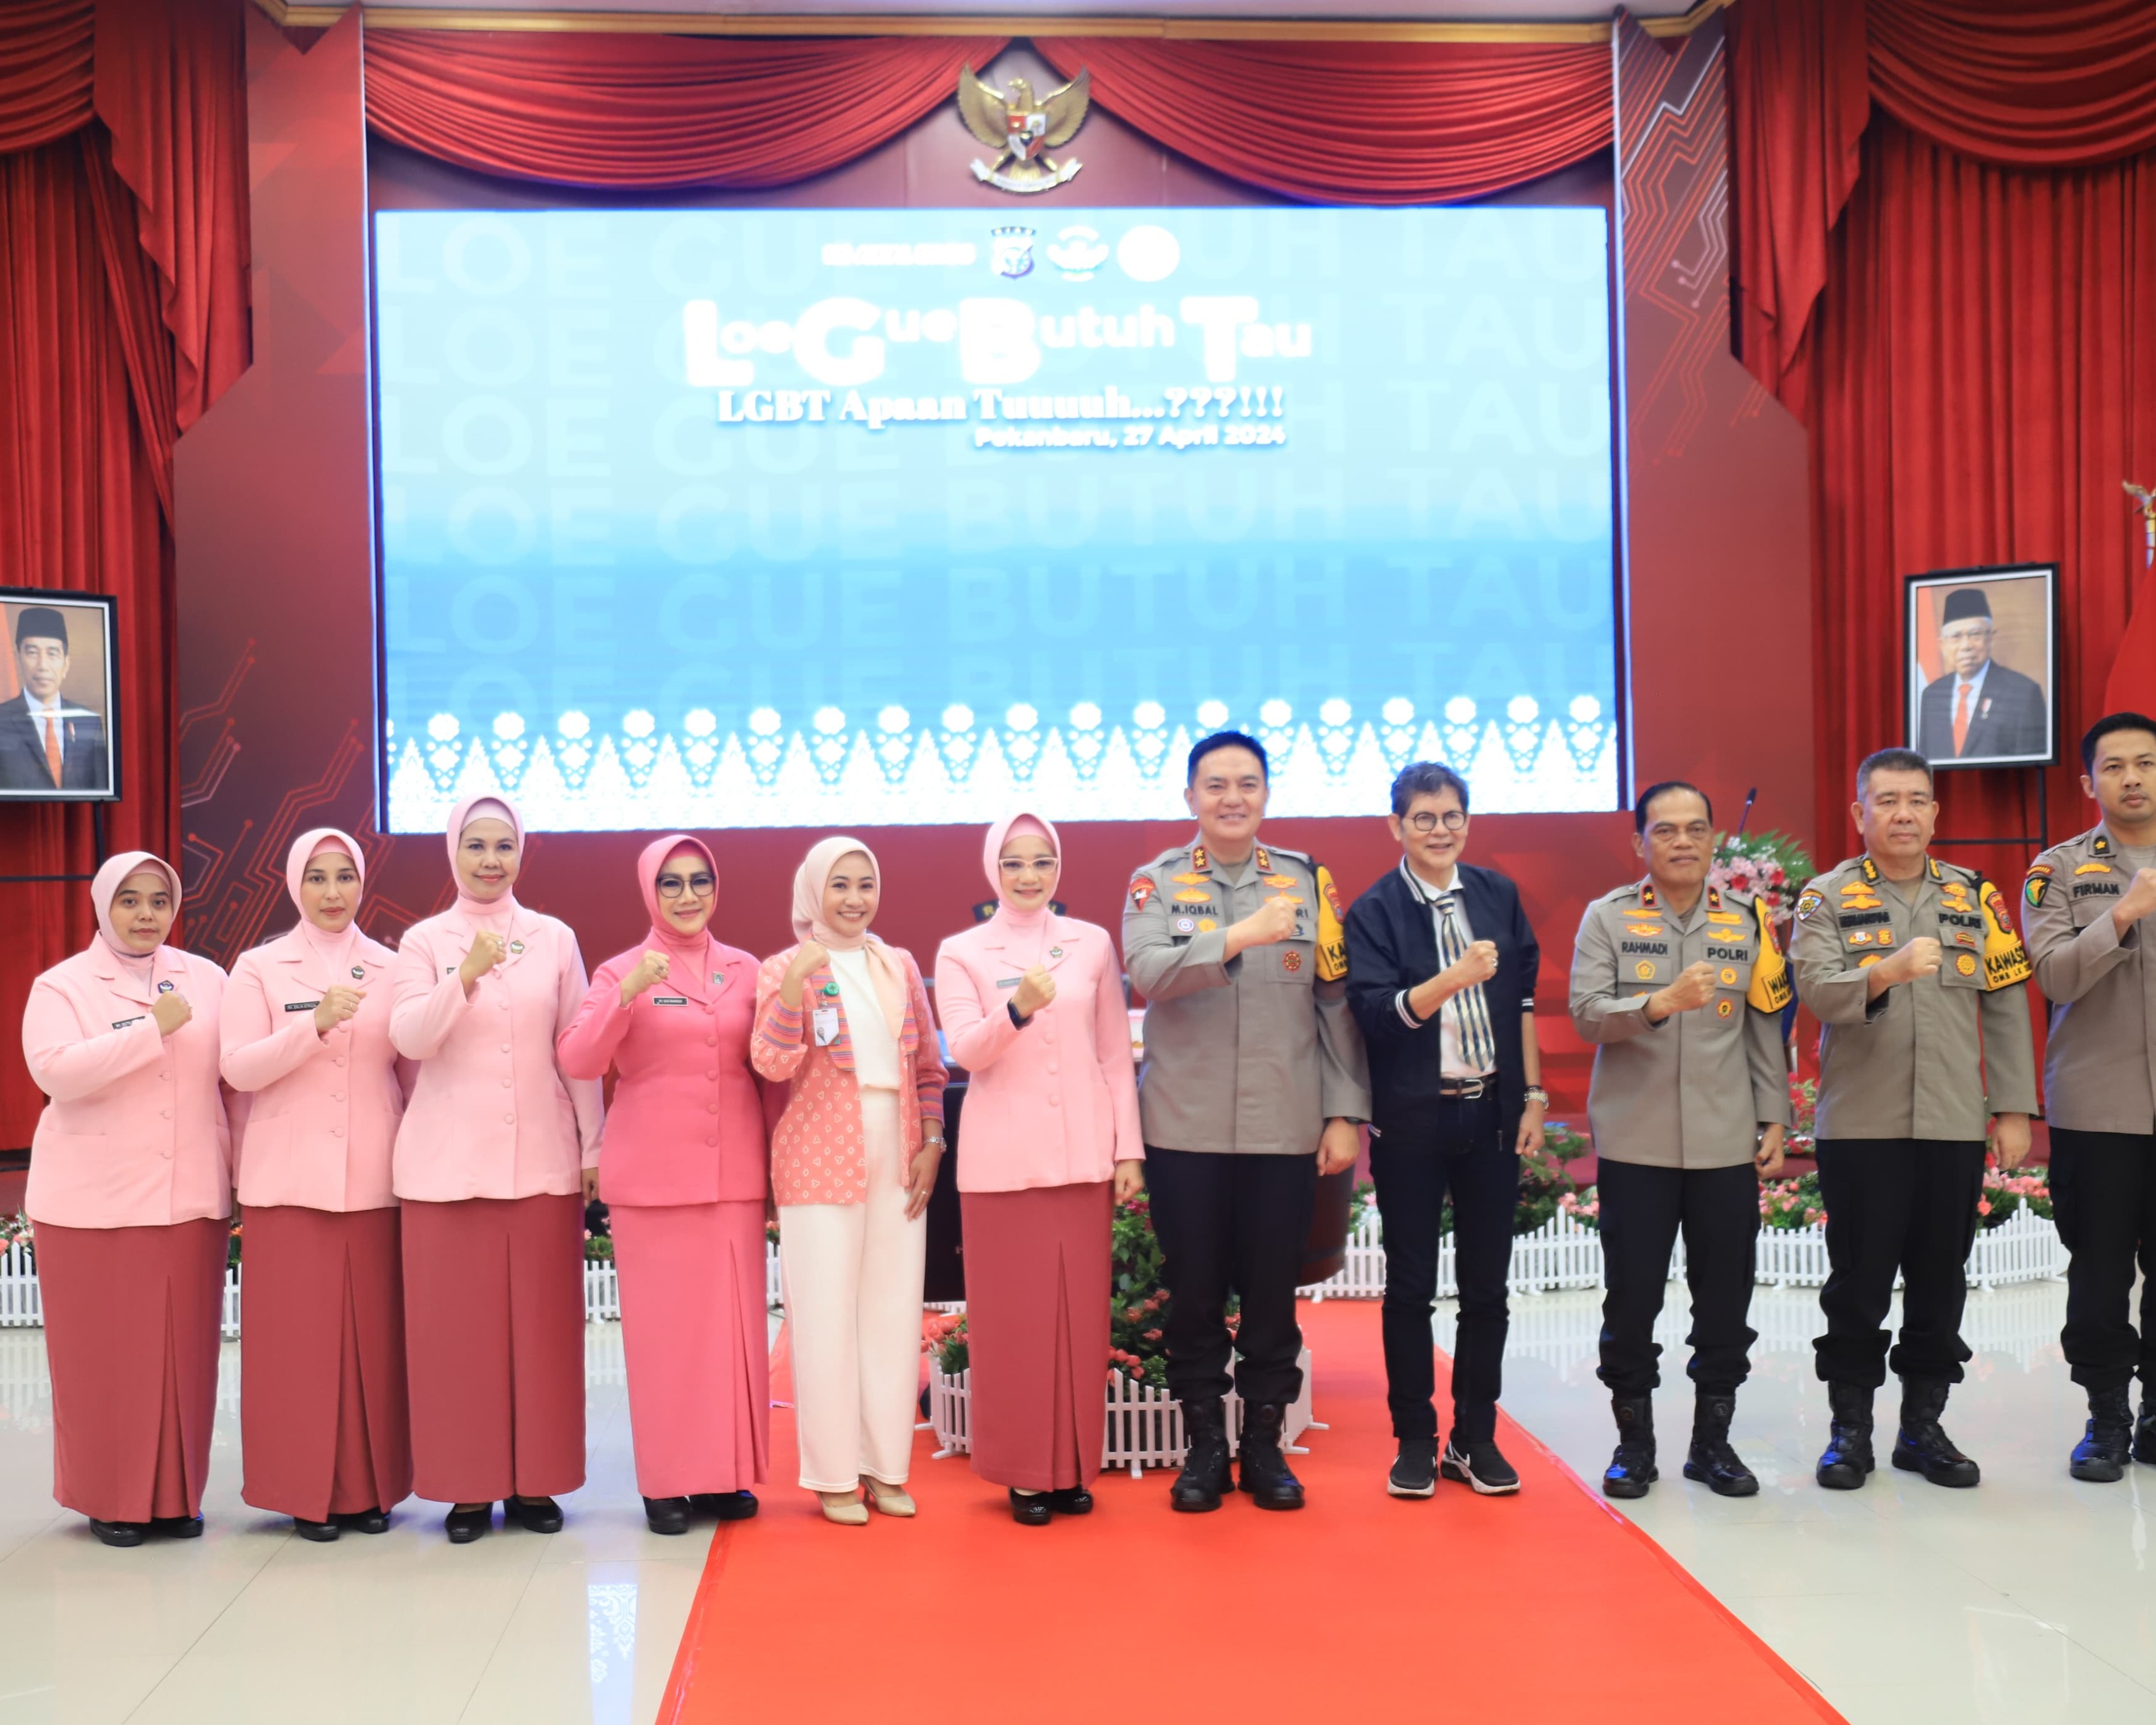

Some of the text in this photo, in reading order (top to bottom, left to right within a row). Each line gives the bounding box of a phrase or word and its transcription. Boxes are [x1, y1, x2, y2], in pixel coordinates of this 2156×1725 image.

[718, 390, 831, 421] LGBT
[839, 389, 967, 429] Apaan
[1123, 425, 1154, 446] 27
[1158, 425, 1219, 449] April
[1224, 424, 1287, 445] 2024
[2073, 883, 2120, 898] FIRMAN
[1171, 905, 1219, 916] M.IQBAL
[1939, 913, 1982, 929] POLRI
[1621, 941, 1668, 955] RAHMADI
[1707, 947, 1748, 961] POLRI
